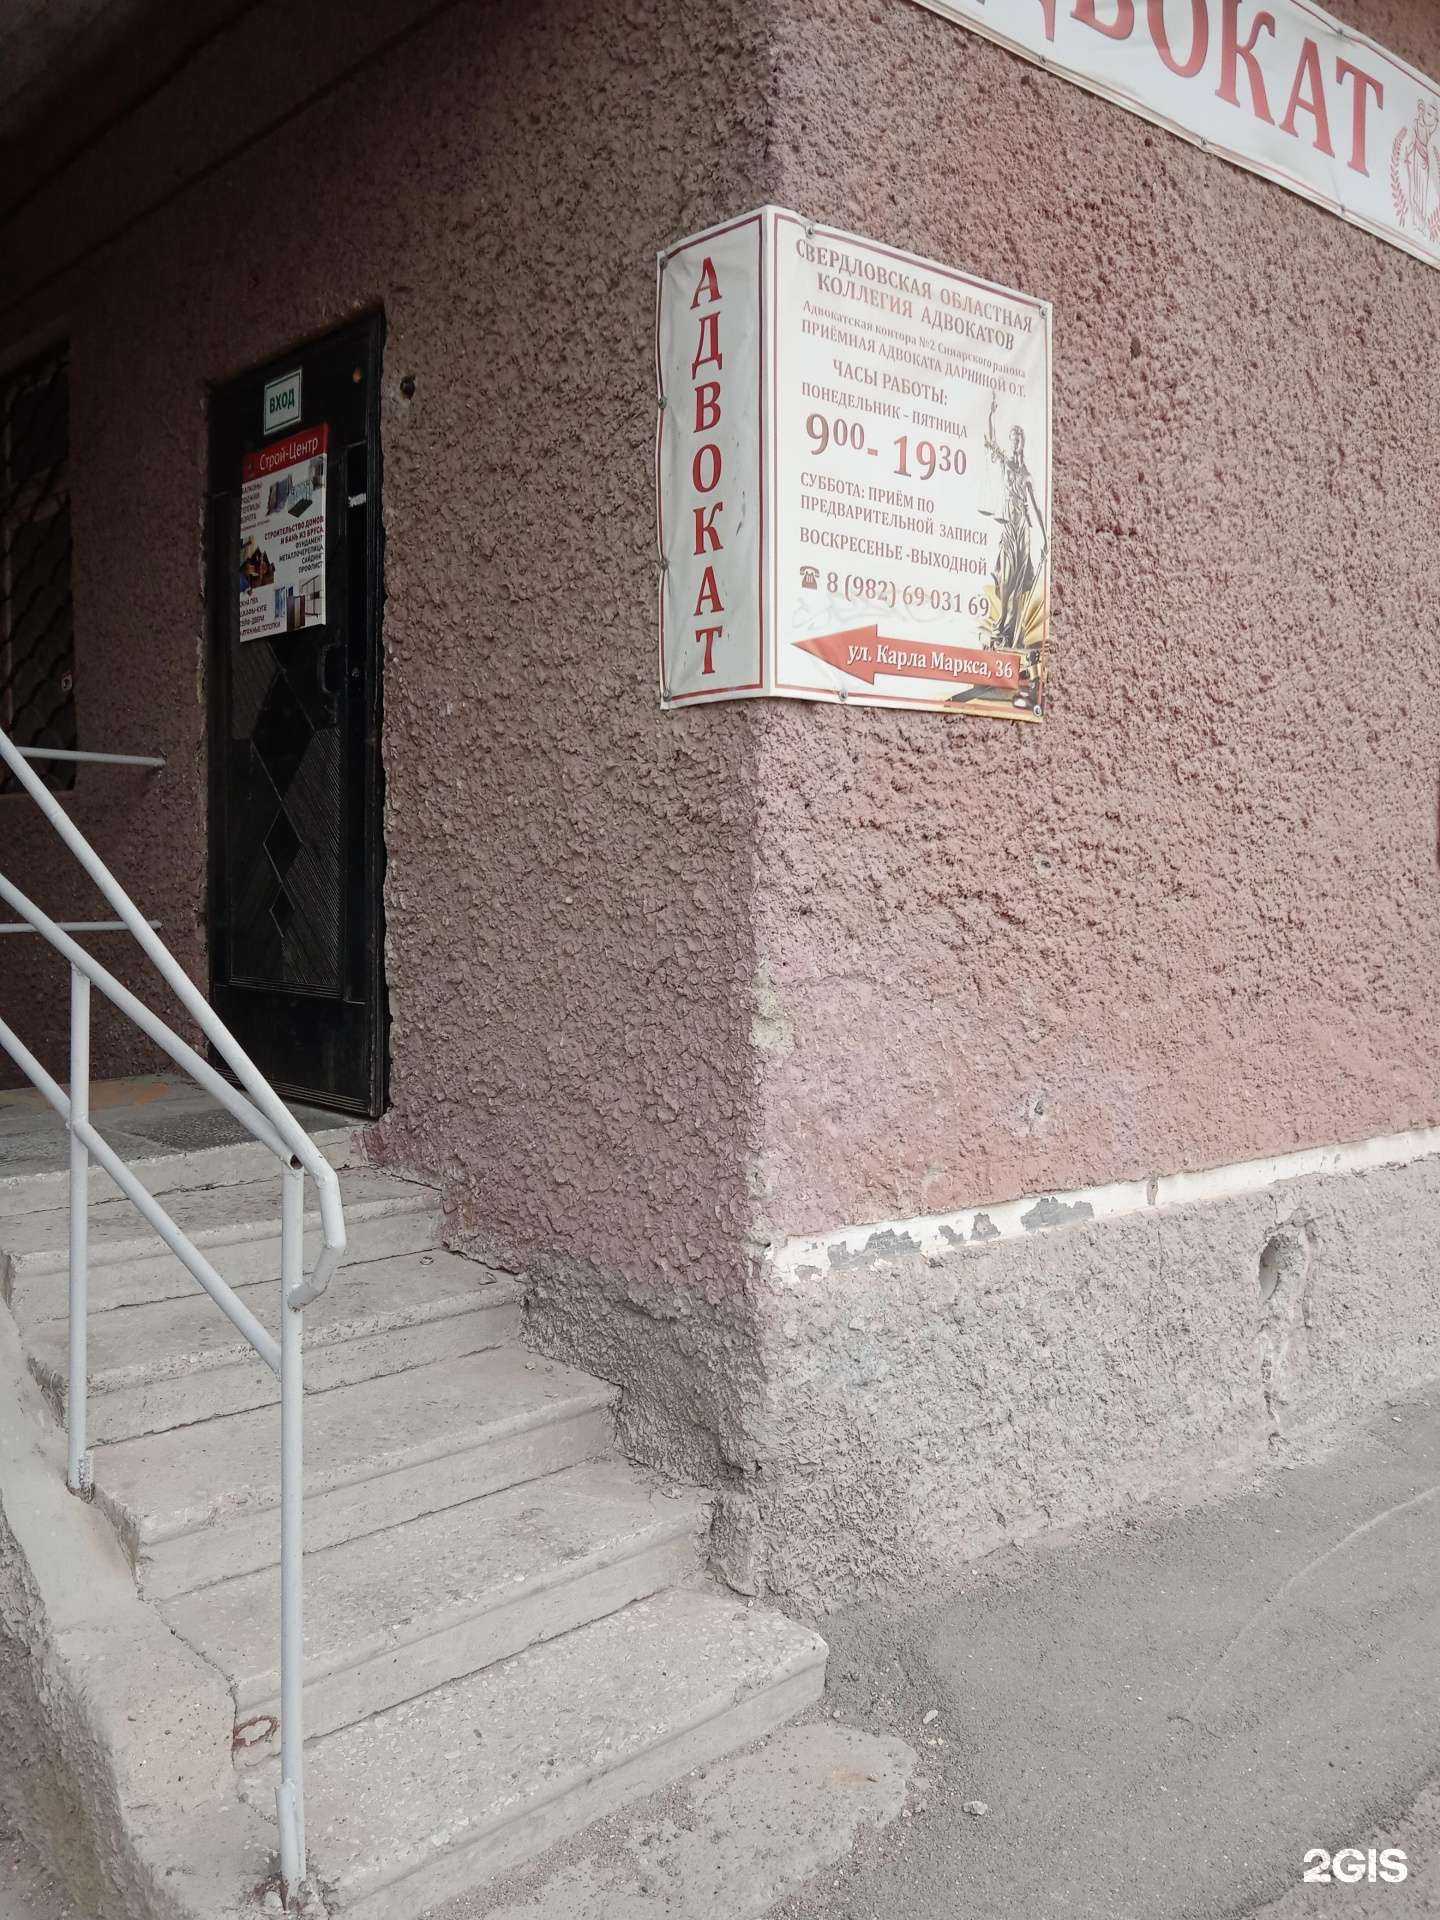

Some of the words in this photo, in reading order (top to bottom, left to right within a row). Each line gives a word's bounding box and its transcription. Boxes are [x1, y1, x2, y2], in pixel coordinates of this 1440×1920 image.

[796, 238, 932, 300] СВЕРДЛОВСКАЯ
[940, 288, 1032, 333] ОБЛАСТНАЯ
[803, 300, 873, 332] Адвокатская
[875, 321, 917, 346] контора
[920, 337, 935, 352] №2
[817, 273, 913, 318] КОЛЛЕГИЯ
[921, 306, 1015, 351] АДВОКАТОВ
[802, 319, 875, 353] ПРИЁМНАЯ
[878, 343, 943, 374] АДВОКАТА
[269, 387, 295, 413] ВХОД
[833, 359, 878, 386] ЧАСЫ
[883, 374, 948, 406] РАБОТЫ:
[802, 382, 900, 420] ПОНЕДЕЛЬНИК
[912, 411, 968, 439] ПЯТНИЦА
[259, 438, 319, 471] Строй-Центр
[690, 257, 724, 675] АДВОКАТ
[800, 471, 865, 499] СУББОТА:
[868, 485, 913, 508] ПРИЁМ
[917, 497, 934, 513] ПО
[800, 495, 934, 535] ПРЕДВАРИТЕЛЬНОЙ
[939, 523, 988, 546] ЗАПИСИ
[800, 527, 903, 561] ВОСКРЕСЕНЬЕ
[827, 571, 838, 593] 8
[844, 574, 896, 609] (982)
[903, 585, 924, 607] 69
[930, 589, 962, 613] 031
[968, 596, 989, 617] 69
[847, 643, 872, 665] ул.
[876, 644, 927, 671] Карла
[930, 652, 991, 677] Маркса,
[995, 661, 1013, 678] 36
